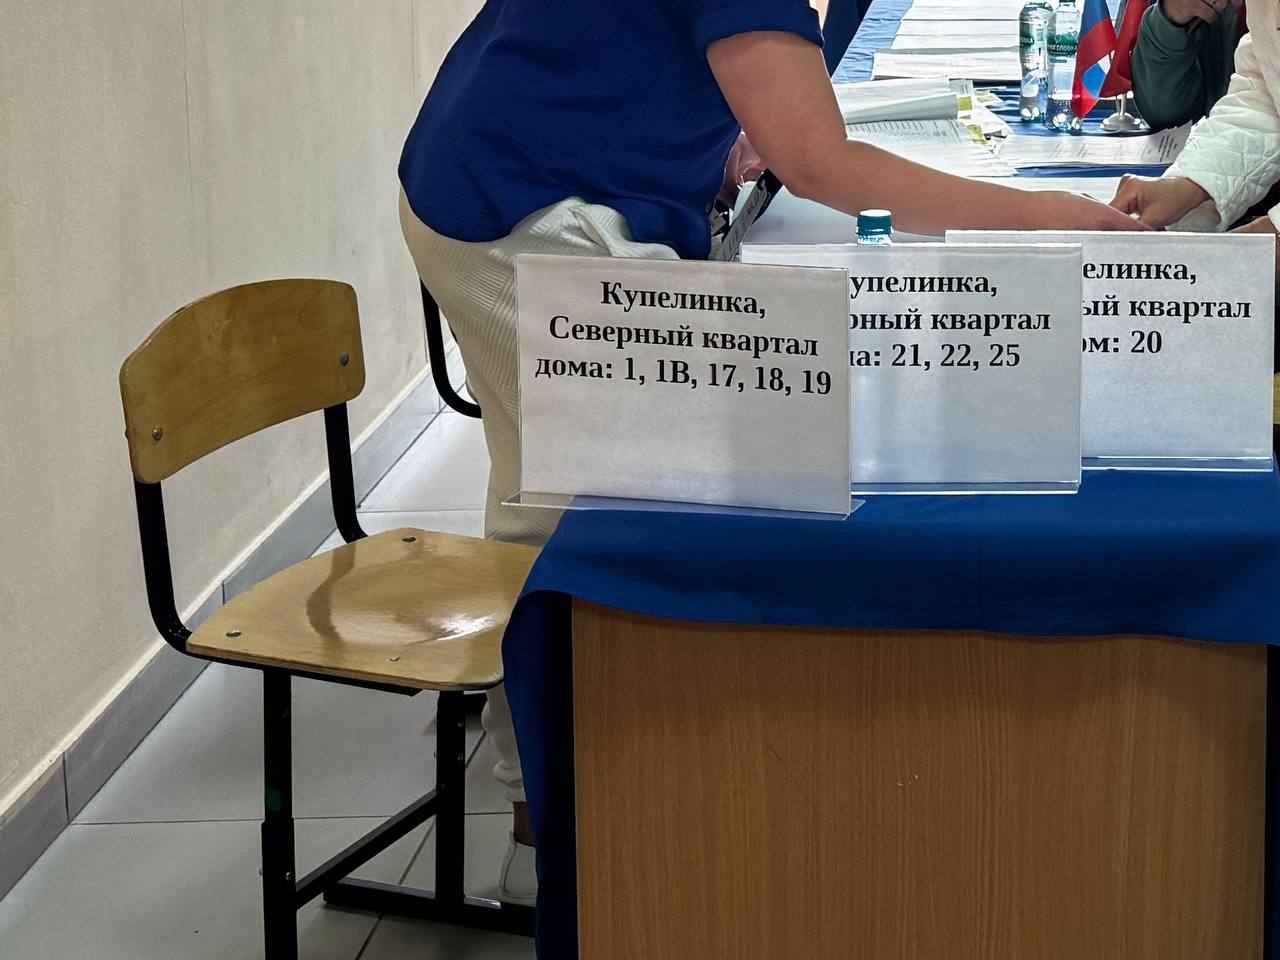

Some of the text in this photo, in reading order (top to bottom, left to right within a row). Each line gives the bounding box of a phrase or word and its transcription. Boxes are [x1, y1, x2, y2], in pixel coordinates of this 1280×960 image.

[1082, 262, 1197, 284] елинка,
[850, 276, 997, 299] упелинка,
[600, 281, 766, 319] Купелинка,
[1128, 300, 1251, 324] квартал
[549, 315, 818, 358] Северный квартал
[930, 313, 1052, 336] квартал
[1130, 330, 1163, 354] 20
[891, 343, 931, 371] 21,
[940, 343, 980, 371] 22,
[989, 343, 1020, 367] 25
[535, 357, 832, 396] дома: 1, 1В, 17, 18, 19
